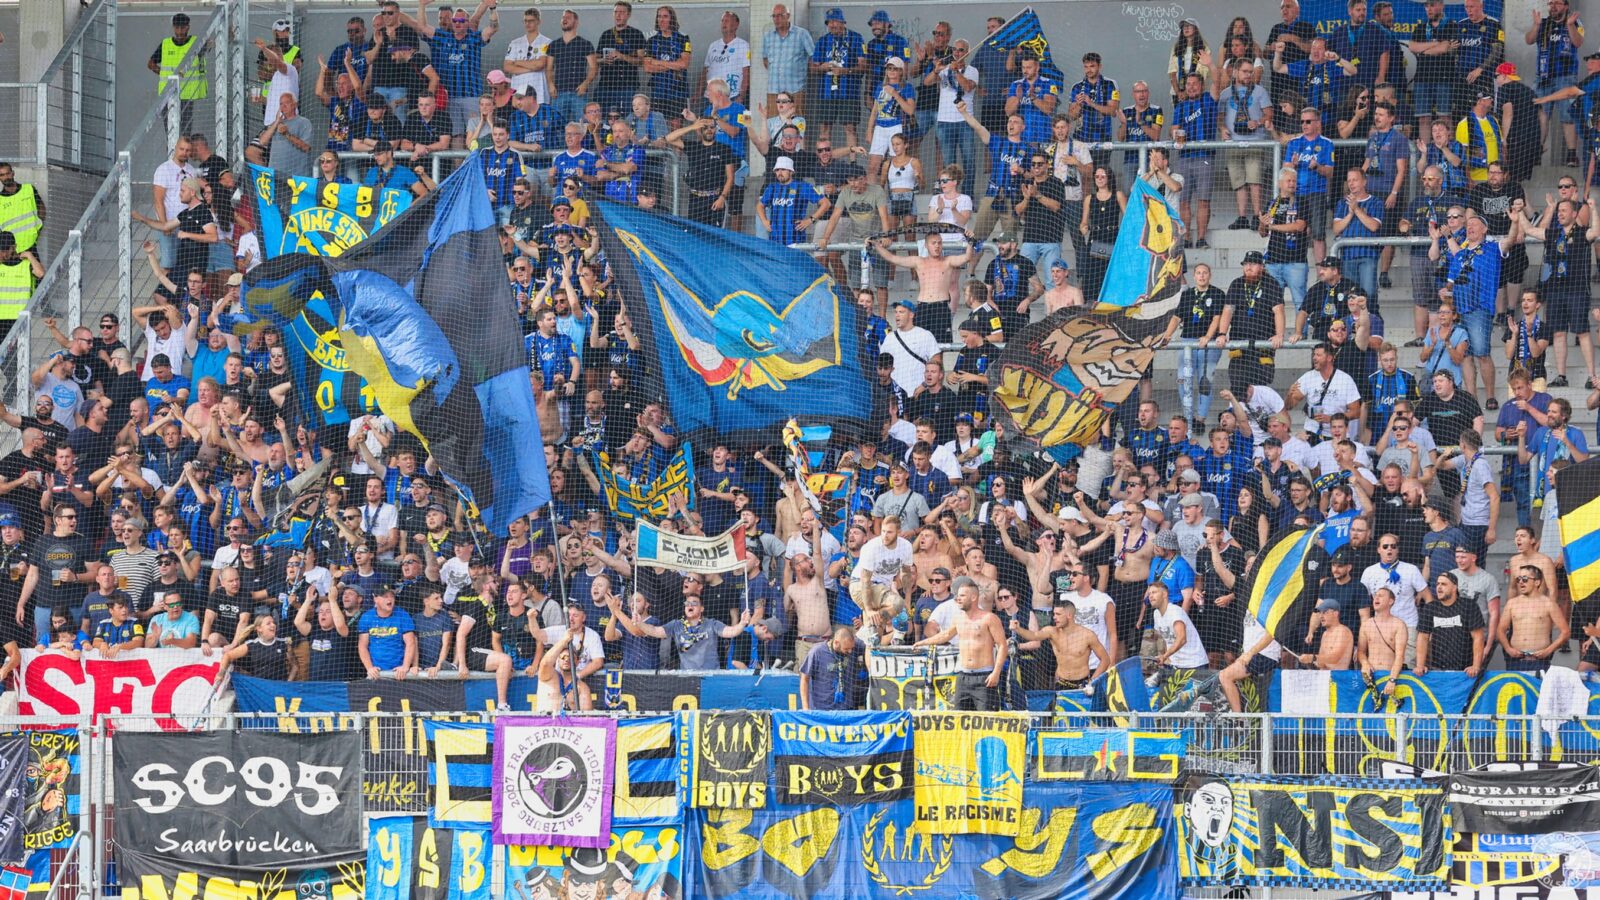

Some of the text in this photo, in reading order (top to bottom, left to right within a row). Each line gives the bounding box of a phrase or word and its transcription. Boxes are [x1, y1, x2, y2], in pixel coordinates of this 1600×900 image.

[960, 715, 1030, 734] CONTRE
[30, 732, 79, 752] CREW
[131, 755, 344, 816] SC95
[505, 727, 601, 833] FRATERNITÉ VIOLETTE SALZBURG 2007
[698, 780, 767, 808] BOYS
[917, 804, 1017, 823] LE RACISME
[154, 828, 319, 854] Saarbrücken
